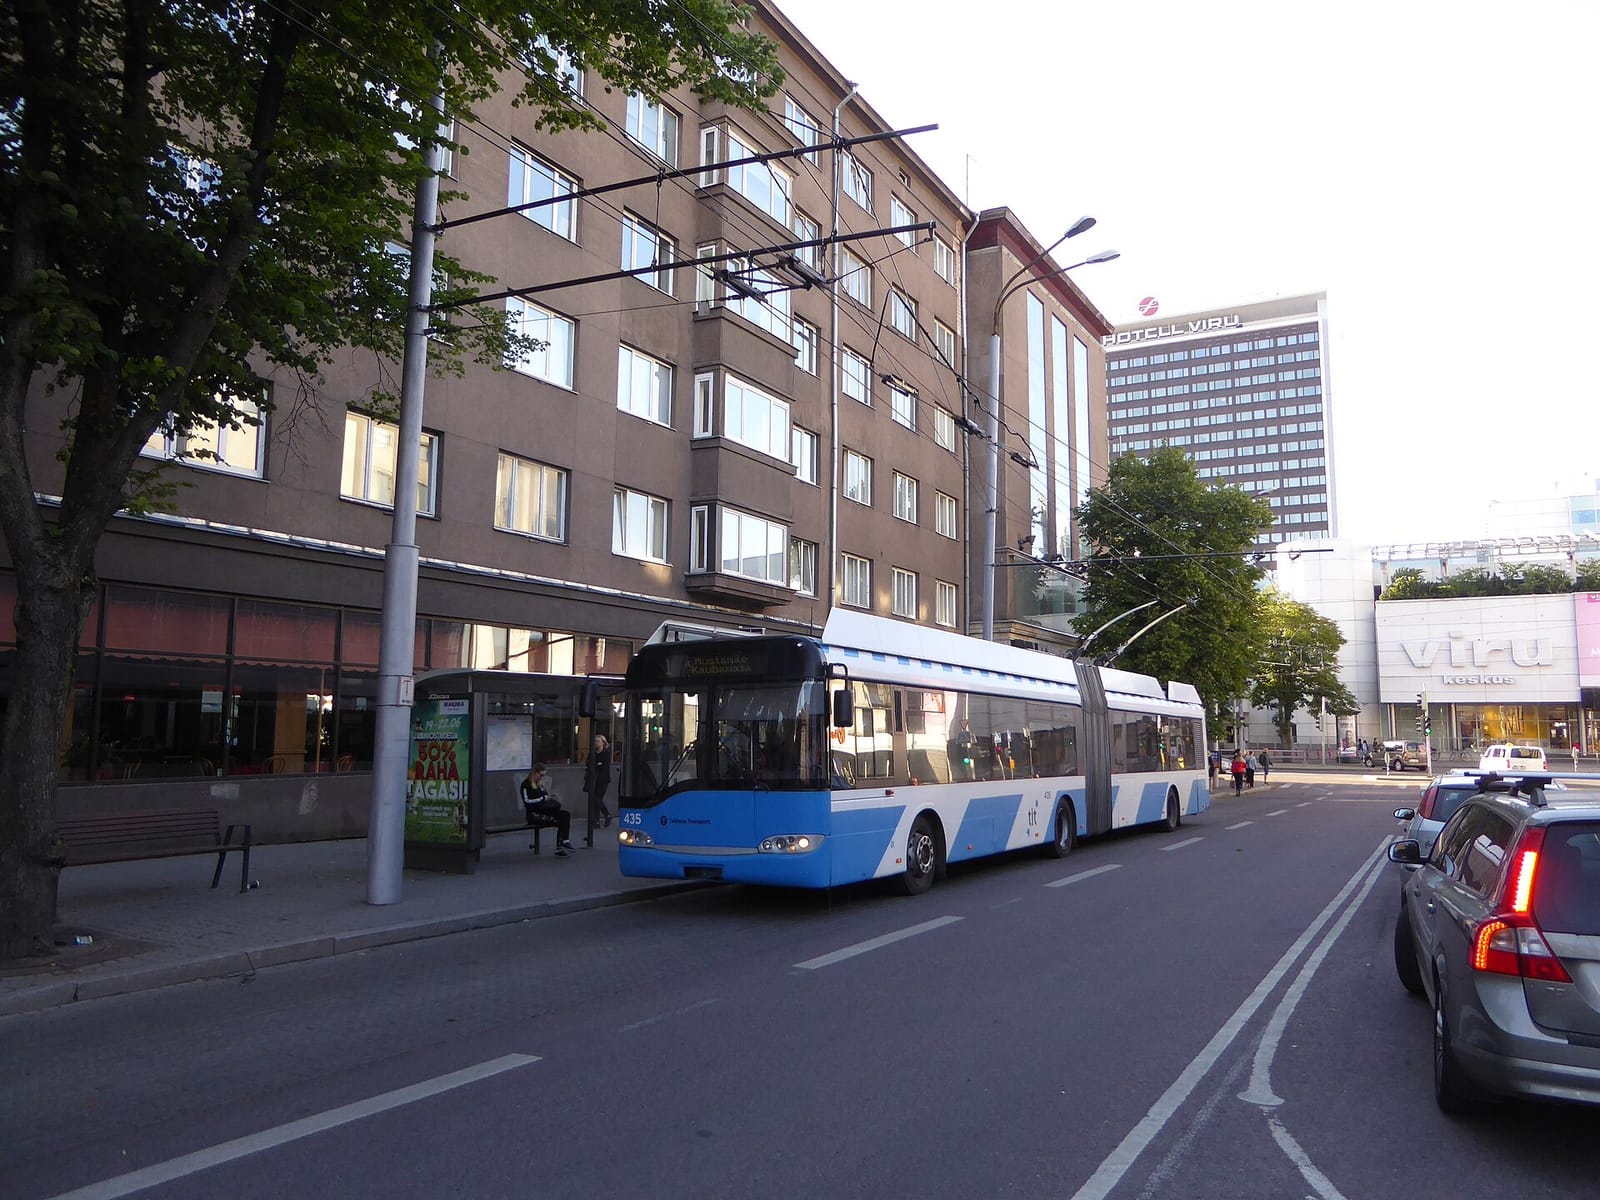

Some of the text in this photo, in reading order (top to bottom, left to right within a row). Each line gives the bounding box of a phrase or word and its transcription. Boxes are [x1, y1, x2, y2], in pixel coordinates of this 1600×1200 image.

[1188, 314, 1241, 333] VIRU
[1400, 630, 1553, 668] viru
[1442, 674, 1516, 686] keskus
[418, 740, 457, 762] 50%
[414, 760, 460, 780] RAHA
[406, 779, 469, 801] TAGASI!
[623, 812, 642, 825] 435
